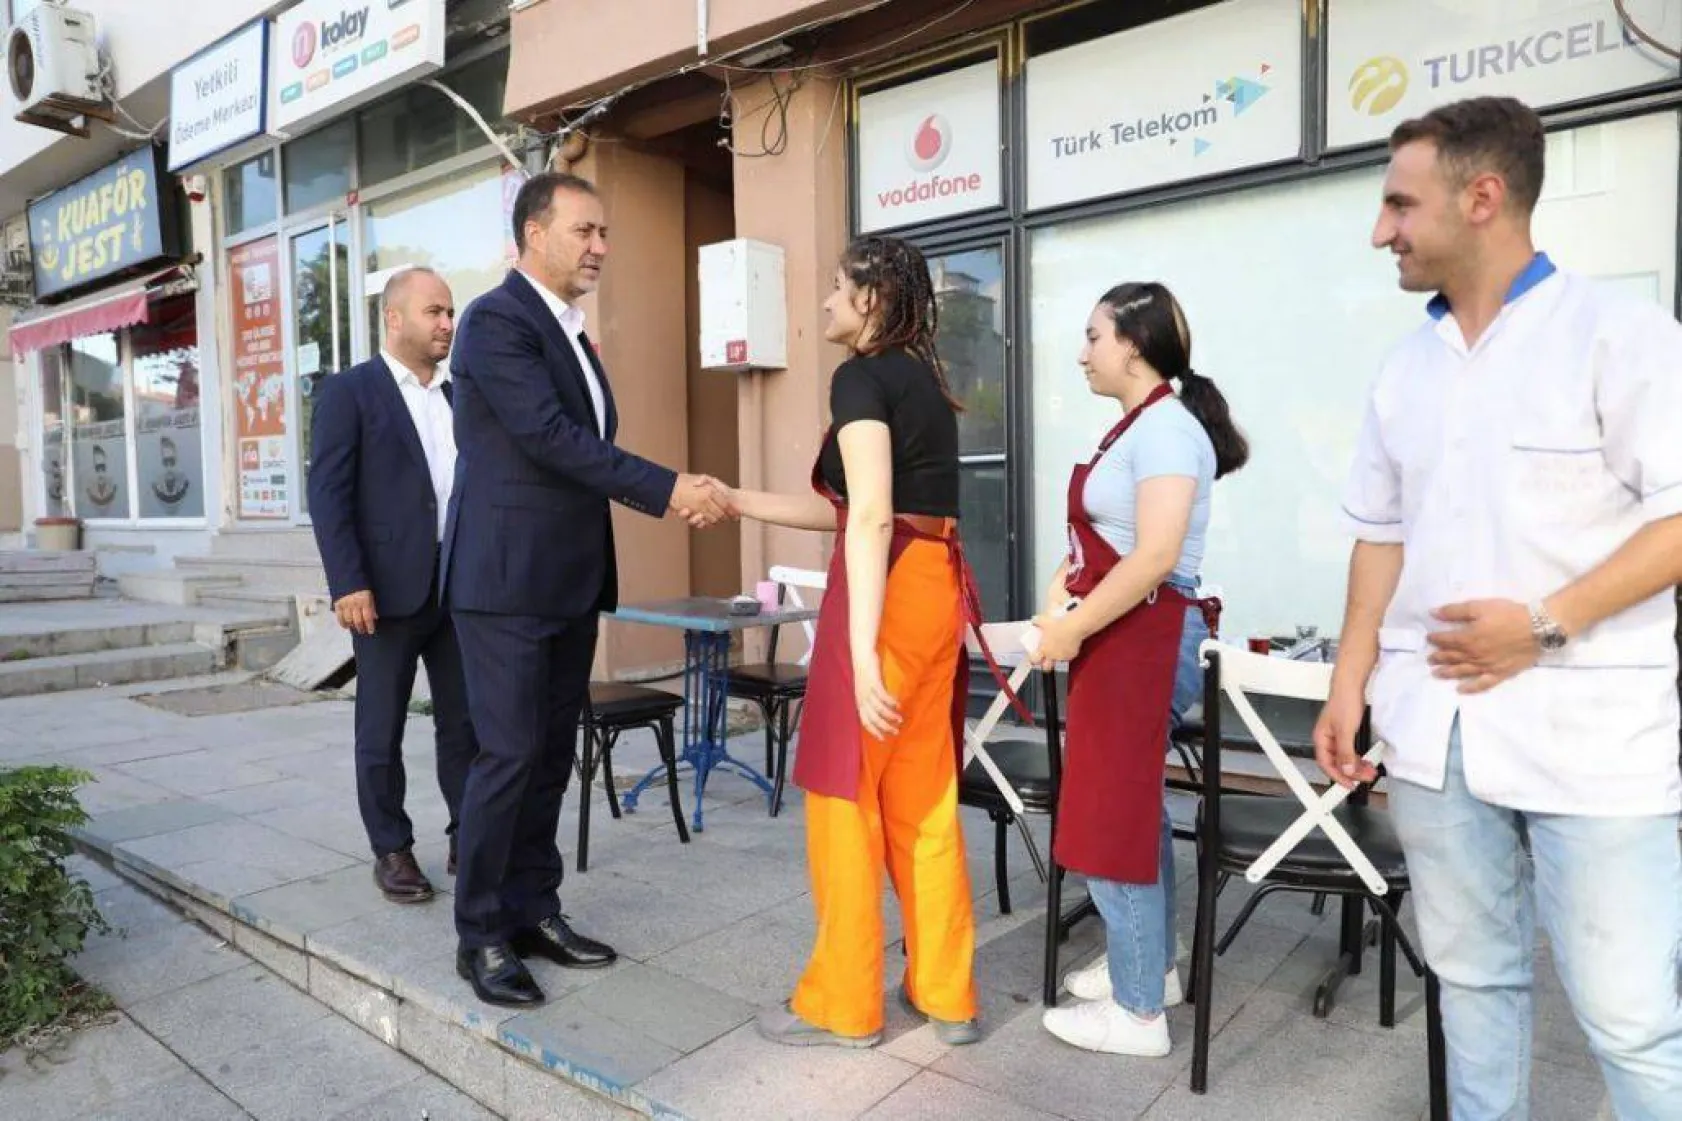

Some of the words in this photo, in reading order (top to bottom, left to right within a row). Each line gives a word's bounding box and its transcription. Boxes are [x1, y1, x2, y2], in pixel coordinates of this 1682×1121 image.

[321, 6, 369, 50] kolay
[1423, 20, 1636, 89] TURKCELL
[193, 58, 239, 101] Yetkili
[175, 116, 212, 145] Ödeme
[212, 86, 258, 127] Merkezi
[1051, 130, 1102, 158] Türk
[1110, 106, 1217, 145] Telekom
[57, 164, 147, 243] KUAFÖR
[877, 172, 981, 208] vodafone
[61, 222, 126, 281] JEST
